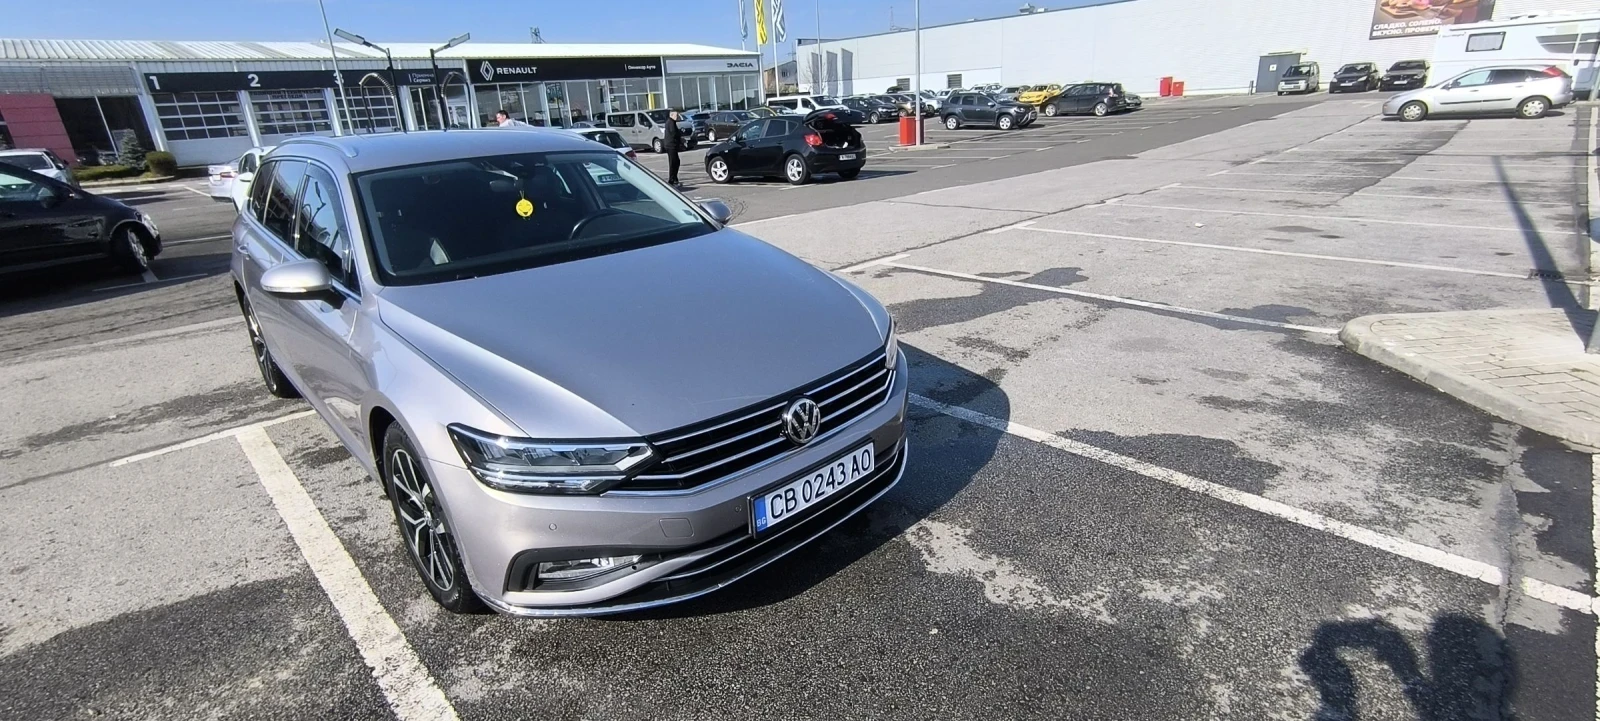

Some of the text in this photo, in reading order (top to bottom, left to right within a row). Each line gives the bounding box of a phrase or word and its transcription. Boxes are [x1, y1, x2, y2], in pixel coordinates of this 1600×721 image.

[1373, 17, 1442, 30] СЛАДКО. СОЛЕНО.
[496, 66, 537, 75] RENAULT
[149, 75, 161, 90] 1
[247, 73, 261, 88] 2
[770, 448, 871, 519] CB 0243 AO
[756, 515, 767, 527] BG
